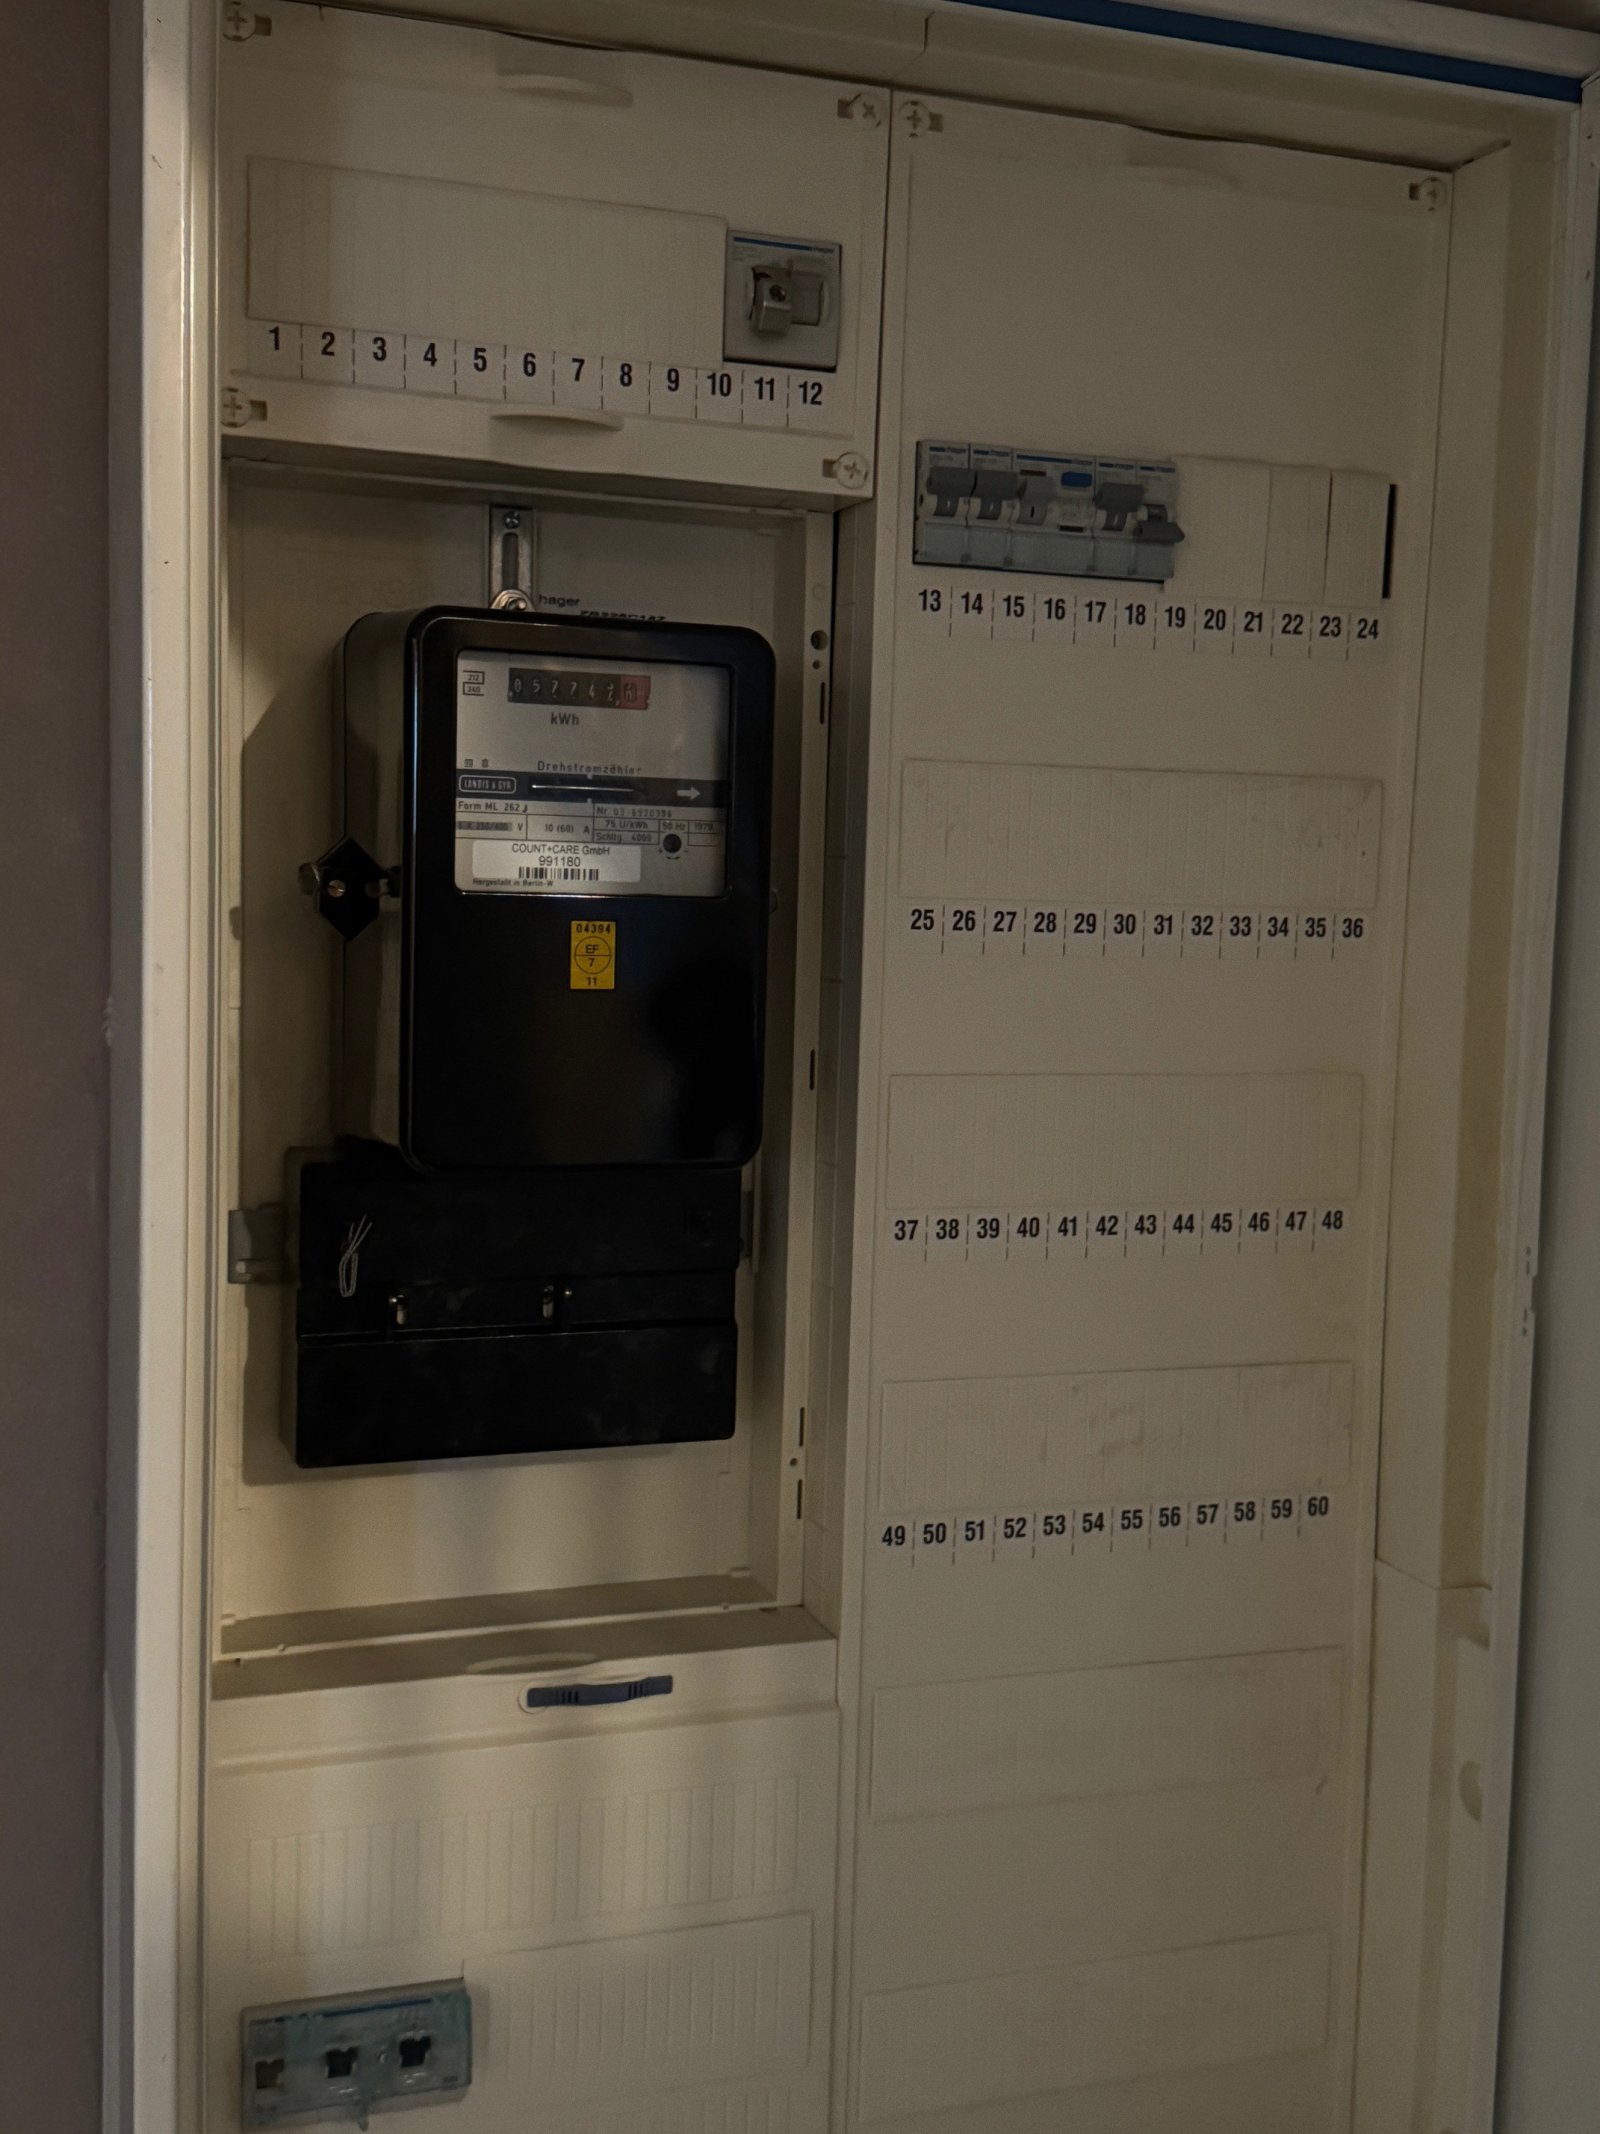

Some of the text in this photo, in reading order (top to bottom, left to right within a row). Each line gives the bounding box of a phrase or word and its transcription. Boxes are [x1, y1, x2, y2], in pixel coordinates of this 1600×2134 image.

[270, 326, 823, 406] 1 2 3 4 5 6 7 8 9 10 11 12
[539, 593, 580, 608] hager
[918, 588, 1379, 640] 13 14 15 16 17 18 19 20 21 22 23 24
[550, 711, 580, 726] kWh
[457, 800, 481, 811] Form
[485, 801, 498, 811] ML
[504, 803, 520, 812] 262
[583, 825, 590, 835] A
[511, 842, 610, 856] COUNT+CARE GmbH
[538, 856, 581, 868] 991180
[910, 908, 1364, 939] 25 26 27 28 29 30 31 32 33 34 35 36
[585, 944, 600, 954] EF
[588, 958, 595, 968] 7
[586, 976, 598, 986] 11
[894, 1210, 1344, 1241] 37 38 39 40 41 42 43 44 45 46 47 48
[881, 1495, 1329, 1547] 49 50 51 52 53 54 55 56 57 58 59 60
